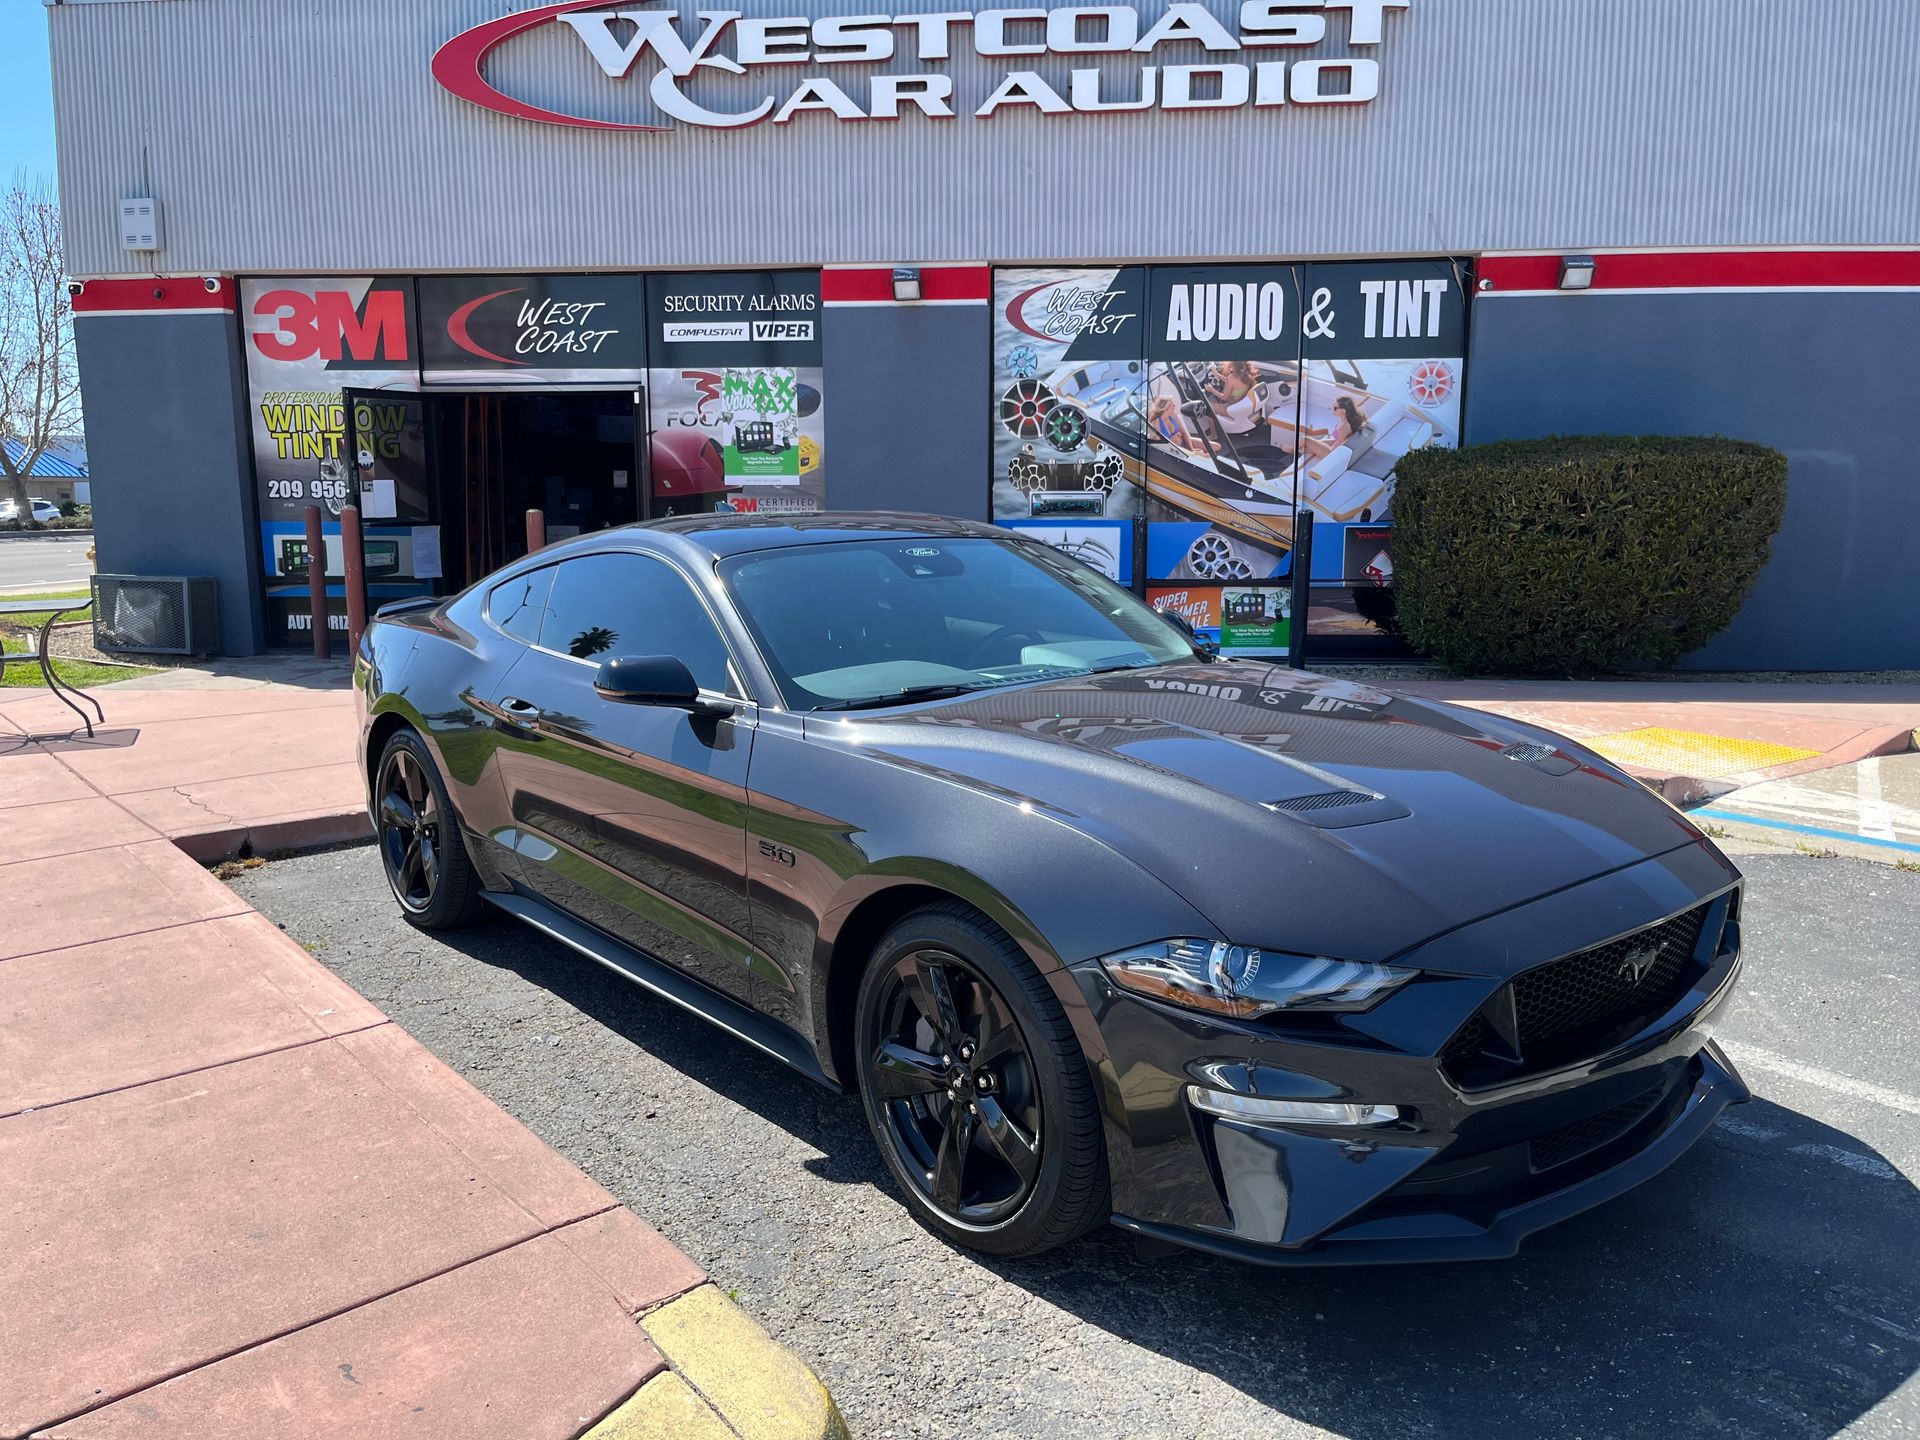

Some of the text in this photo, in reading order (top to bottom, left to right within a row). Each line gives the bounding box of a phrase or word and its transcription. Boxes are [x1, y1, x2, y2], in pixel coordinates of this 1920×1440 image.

[650, 58, 1380, 128] CAR AUDIO
[664, 294, 815, 312] SECURITY ALARMS
[1047, 287, 1126, 313] WEST
[1166, 279, 1448, 341] AUDIO & TINT
[516, 298, 606, 327] WEST
[1044, 312, 1136, 335] COAST
[252, 290, 409, 361] 3M
[670, 323, 810, 338] COMPUSTAR VIPER
[514, 326, 619, 354] COAST
[262, 391, 343, 404] PROFESSIONA
[724, 373, 795, 398] MAX
[724, 393, 757, 411] YOUR
[261, 404, 407, 432] WINDOW
[271, 432, 401, 459] TINTNG
[268, 480, 303, 498] 209
[731, 496, 815, 512] 3M CERTIFIED
[1152, 591, 1188, 610] SUPER
[1190, 613, 1211, 629] ALE
